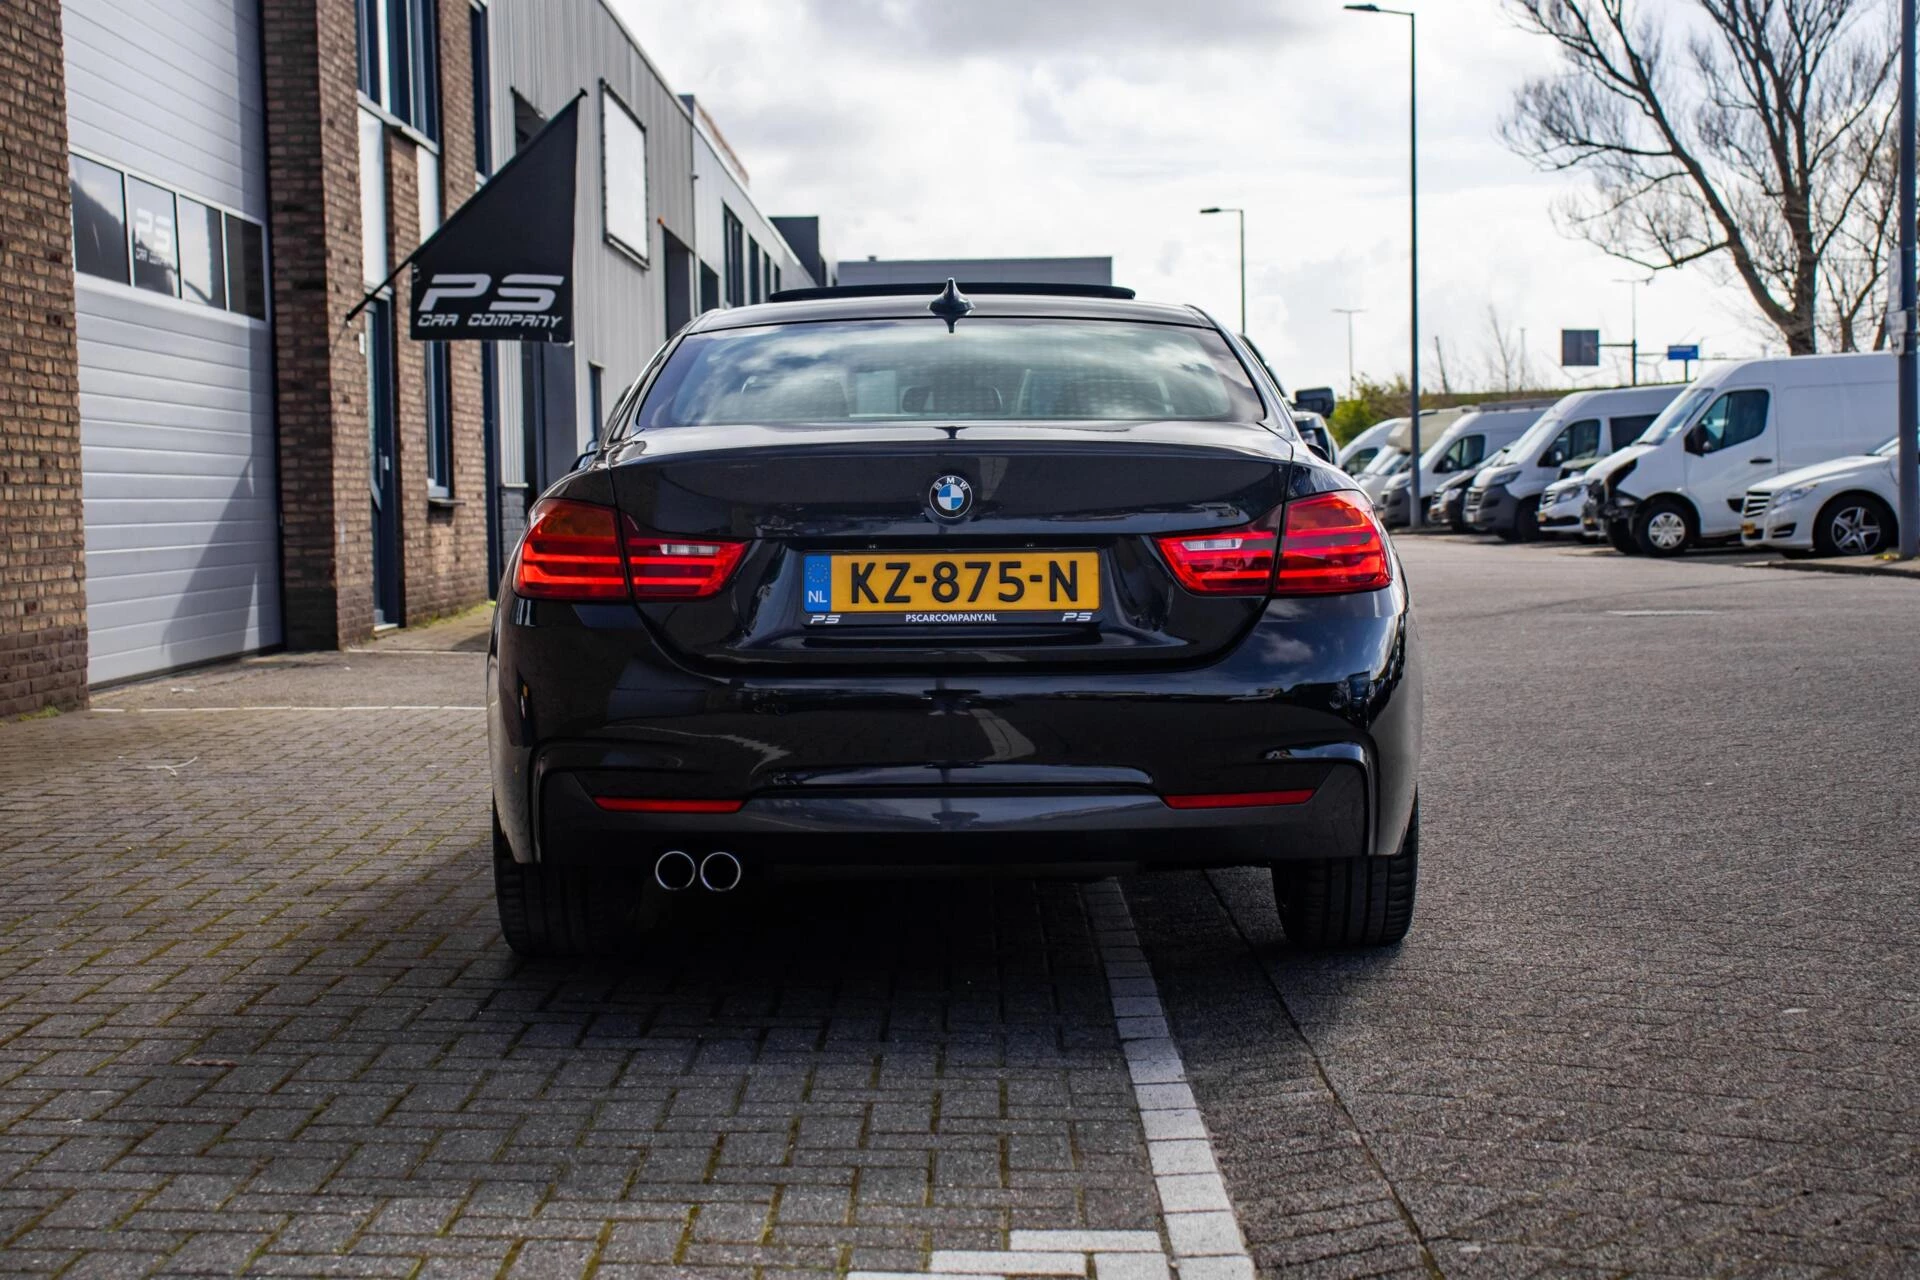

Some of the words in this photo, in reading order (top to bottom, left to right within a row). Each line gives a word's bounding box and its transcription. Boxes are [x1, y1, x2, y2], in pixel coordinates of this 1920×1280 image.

[418, 273, 564, 312] PS
[417, 313, 459, 327] CAR
[467, 313, 562, 328] COMPANY
[933, 477, 968, 490] BMW
[851, 560, 1078, 604] KZ-875-N
[808, 590, 828, 603] NL
[810, 615, 841, 624] PS
[905, 614, 997, 622] PSCARCOMPANY.NL
[1062, 612, 1092, 622] PS
